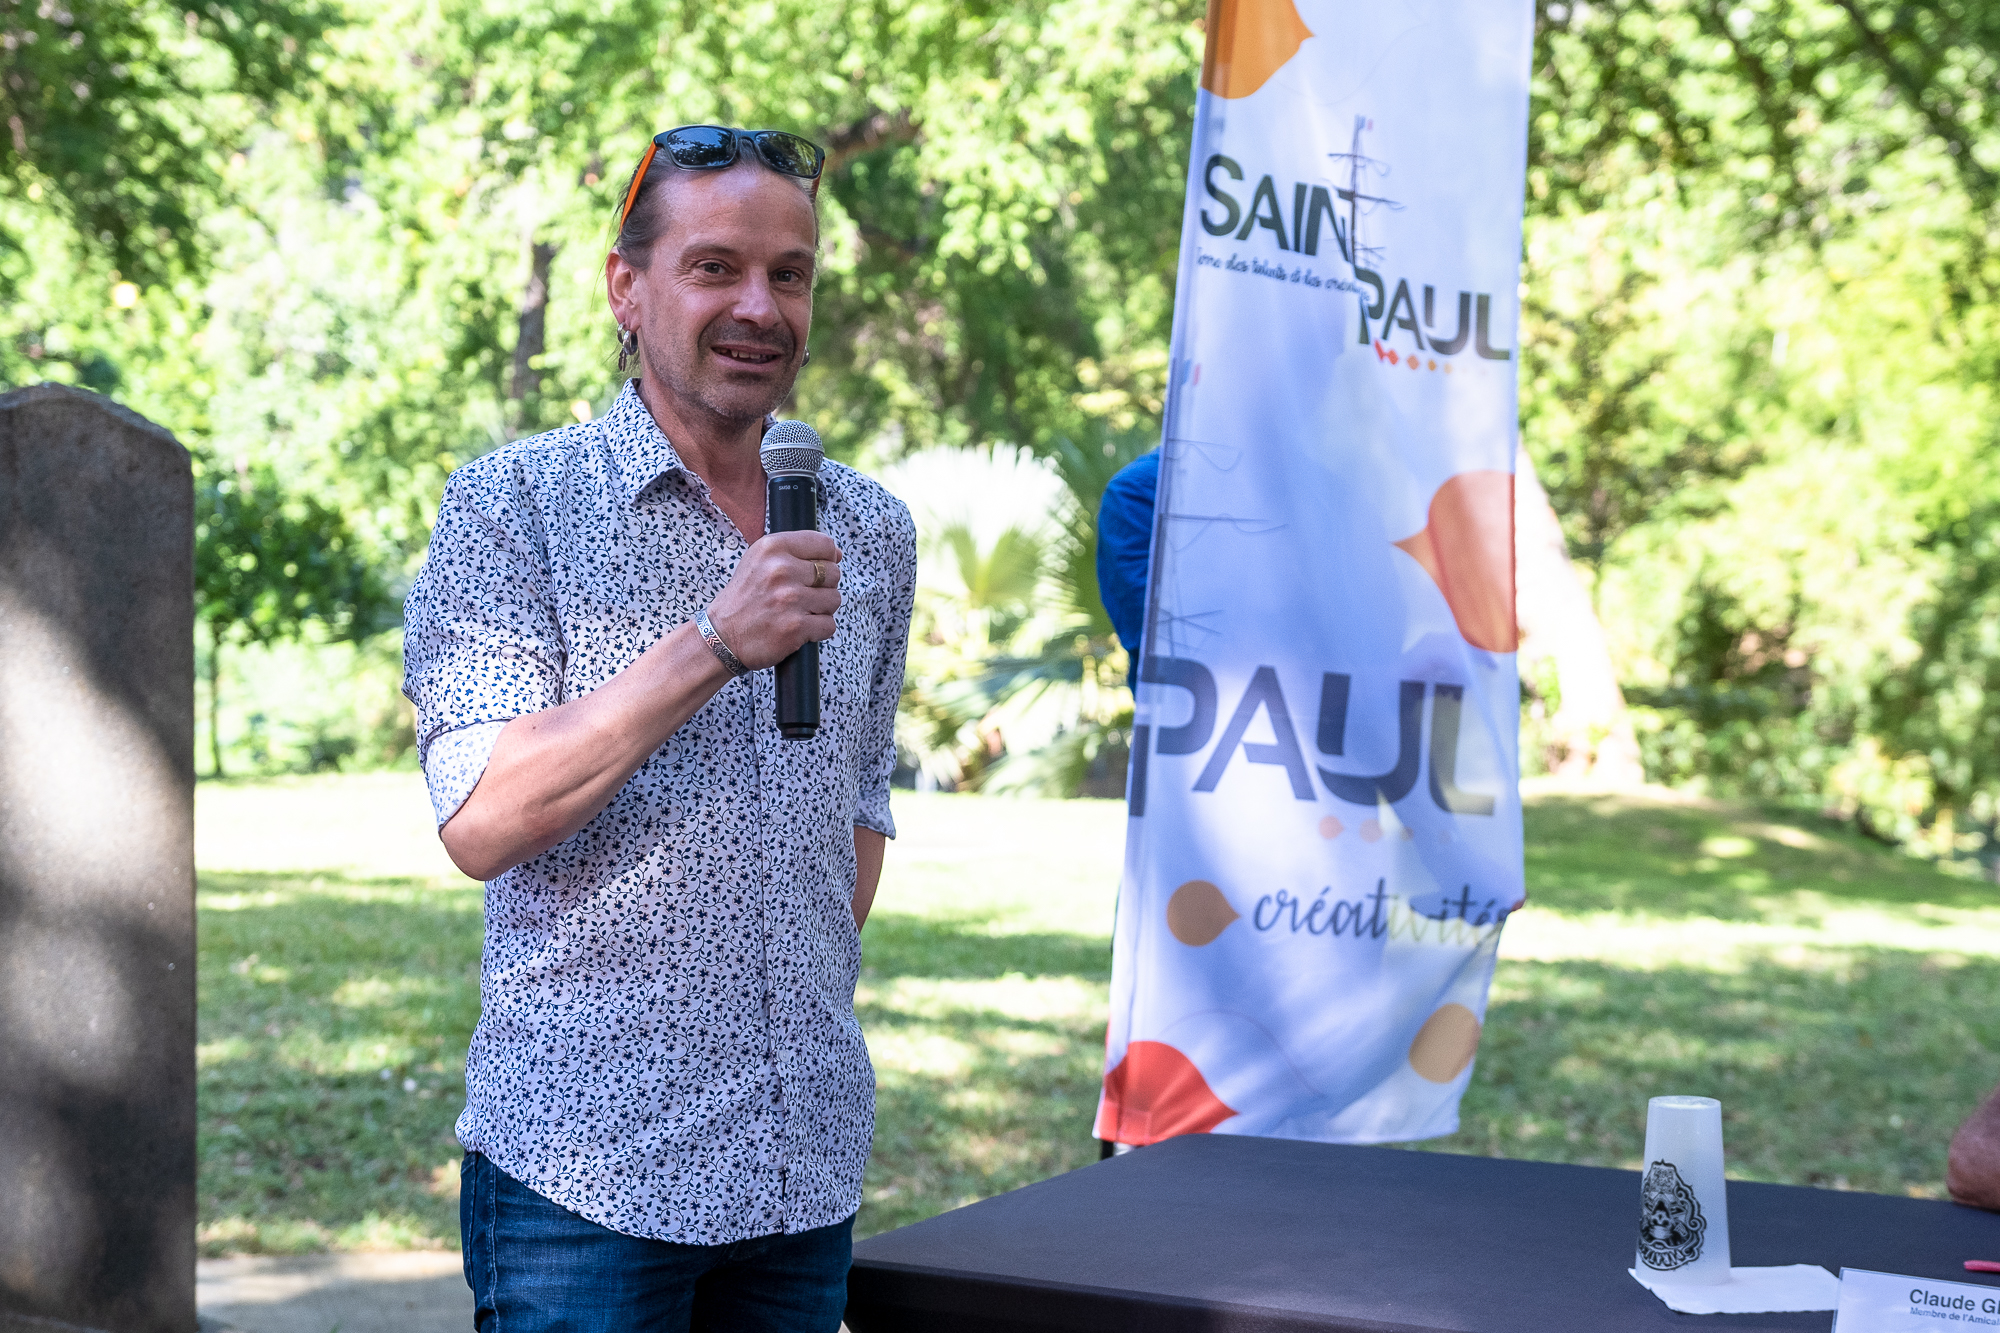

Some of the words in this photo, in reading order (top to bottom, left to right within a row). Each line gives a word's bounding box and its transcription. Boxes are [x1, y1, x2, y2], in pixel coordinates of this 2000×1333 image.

[1355, 267, 1512, 361] PAUL
[1129, 655, 1496, 817] PAUL
[1910, 1289, 1975, 1311] Claude
[1982, 1298, 2000, 1315] G
[1910, 1307, 1946, 1318] Membre
[1949, 1312, 1961, 1320] de
